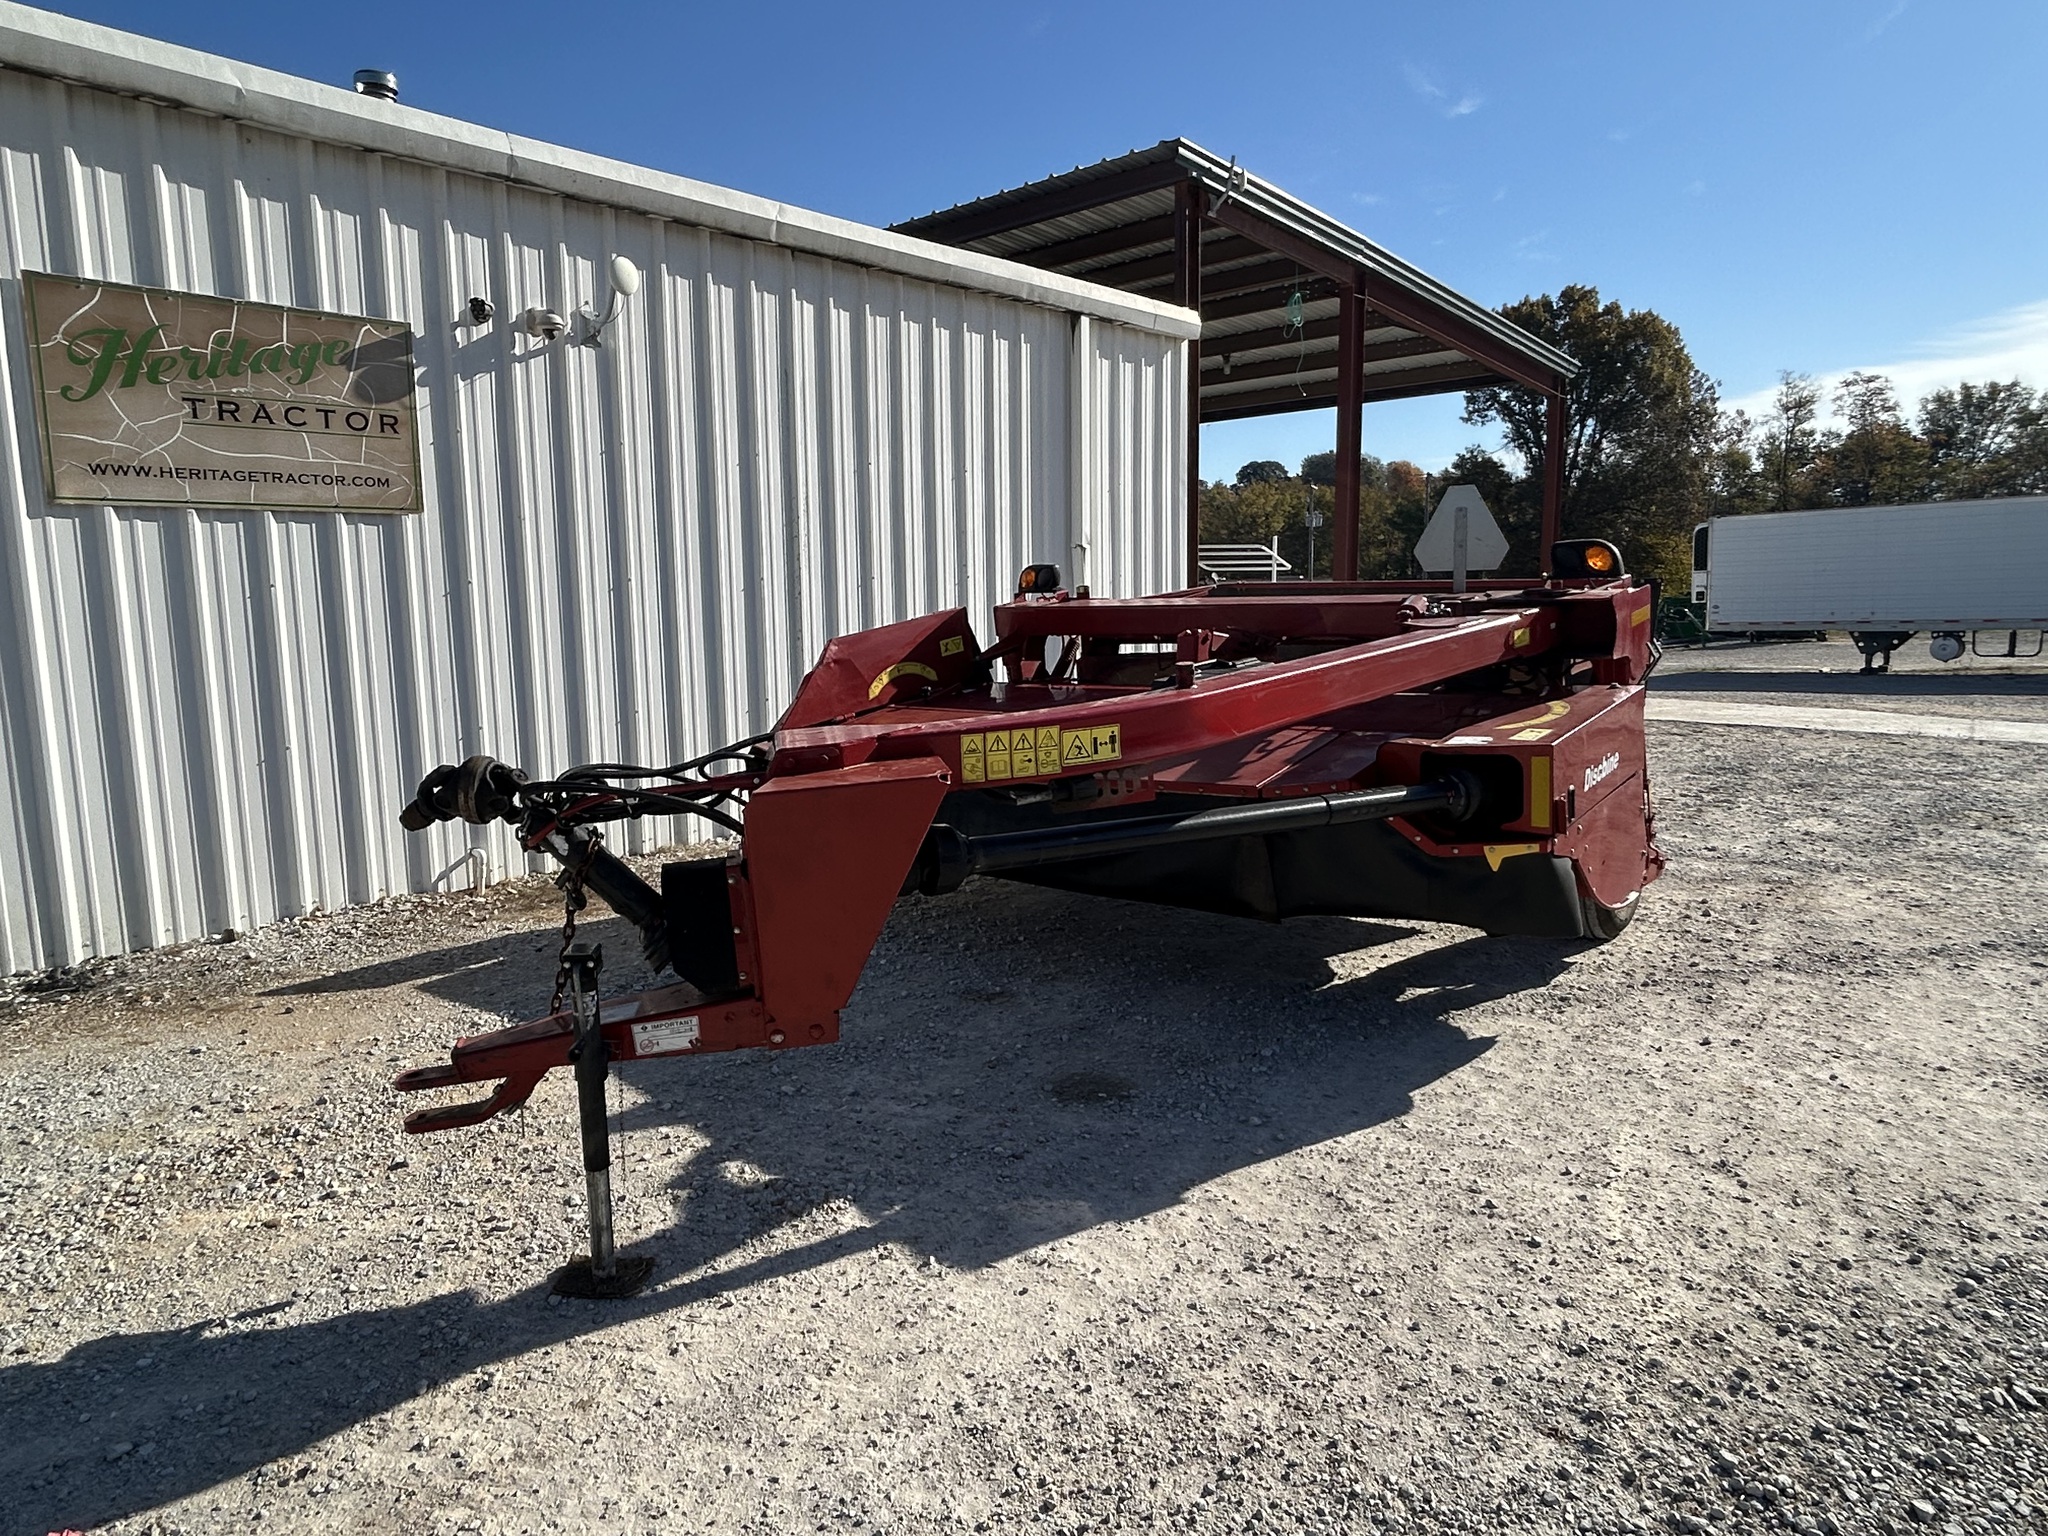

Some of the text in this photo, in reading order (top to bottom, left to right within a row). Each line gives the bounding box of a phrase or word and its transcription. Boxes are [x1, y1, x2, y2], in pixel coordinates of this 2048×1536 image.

[60, 323, 350, 402] Heritage
[181, 397, 400, 434] TRACTOR
[87, 462, 391, 489] WWW.HERITAGETRACTOR.COM
[651, 1019, 693, 1030] IMPORTANT
